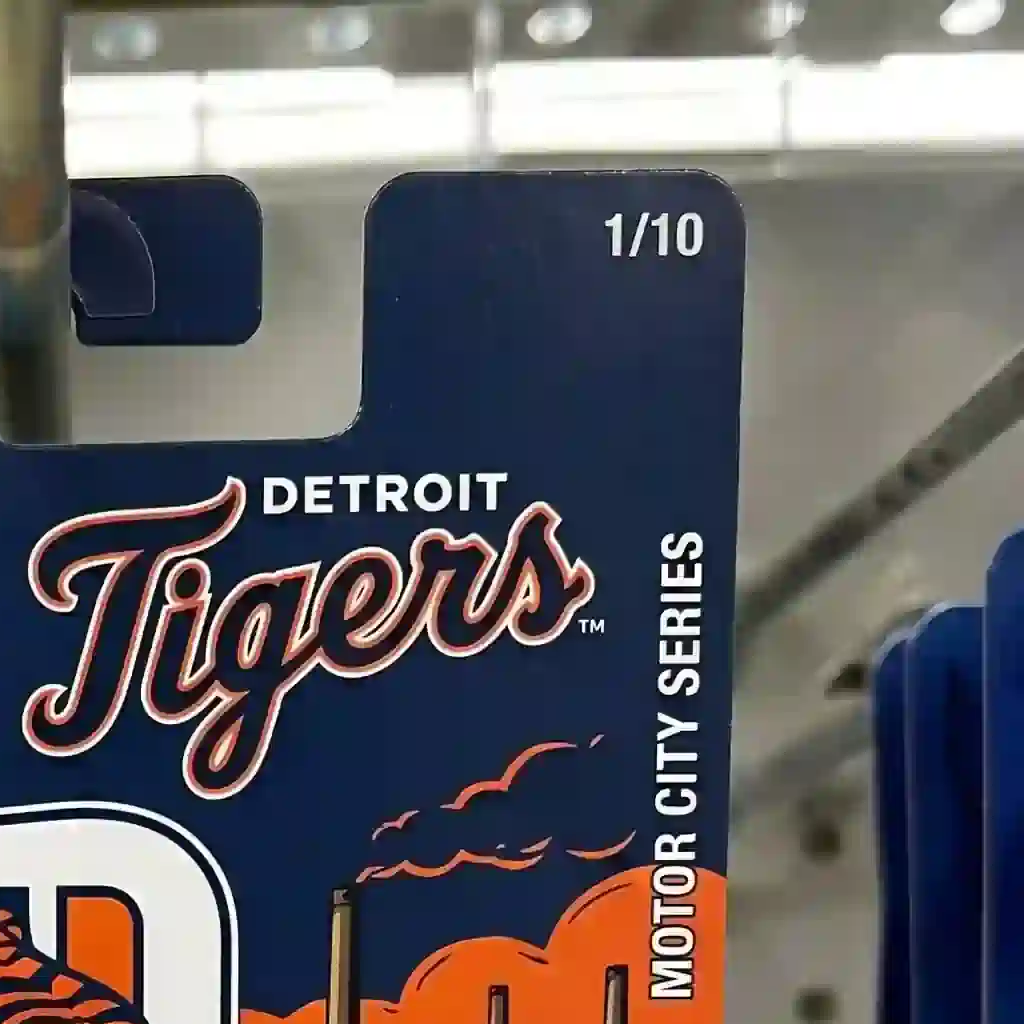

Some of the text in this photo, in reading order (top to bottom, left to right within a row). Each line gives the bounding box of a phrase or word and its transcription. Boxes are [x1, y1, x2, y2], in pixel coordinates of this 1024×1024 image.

[604, 212, 705, 258] 1/10
[262, 472, 508, 515] DETROIT
[22, 475, 596, 800] Tigers
[649, 531, 705, 1000] MOTOR CITY SERIES
